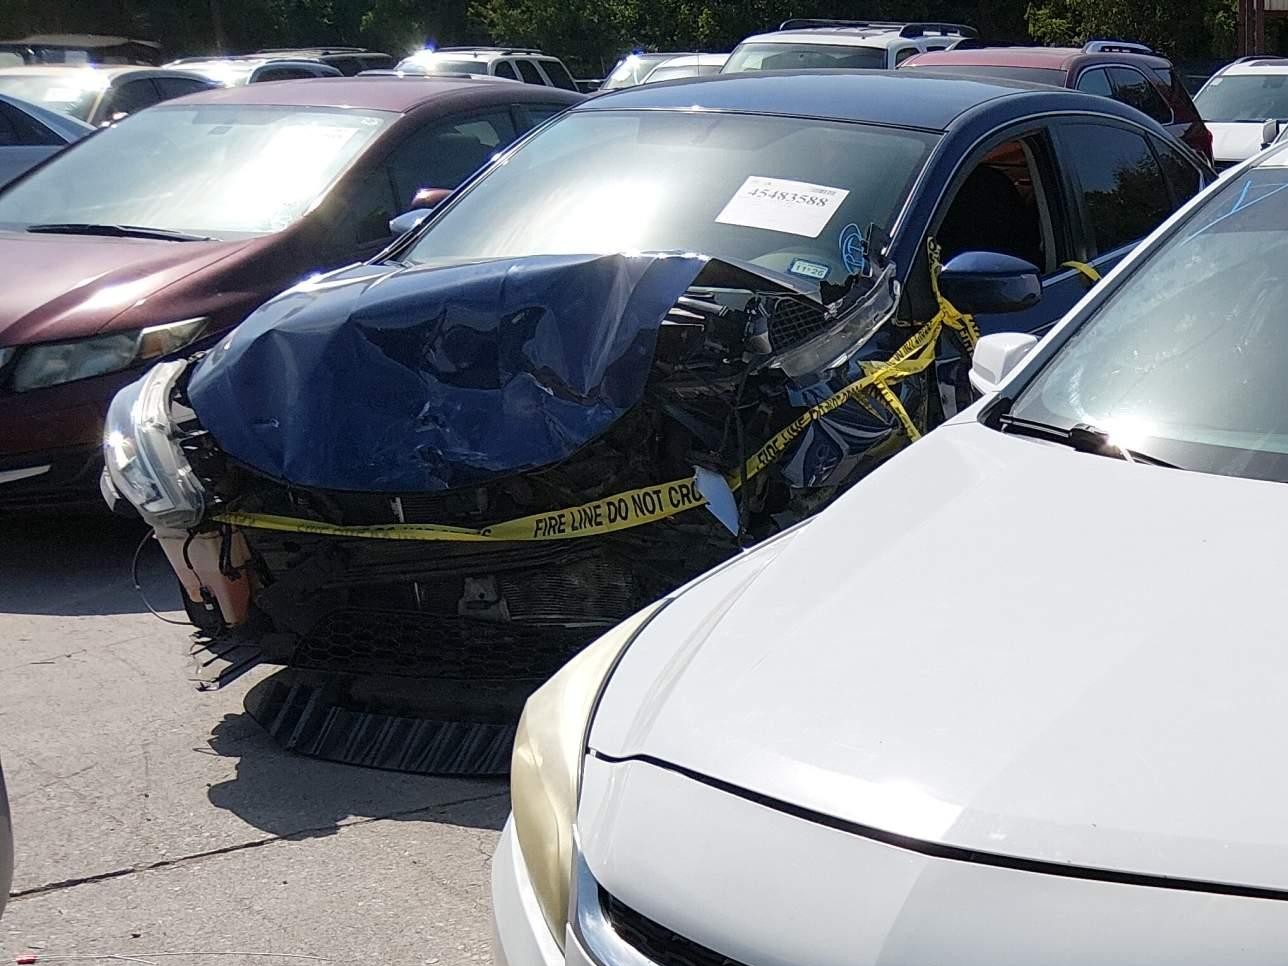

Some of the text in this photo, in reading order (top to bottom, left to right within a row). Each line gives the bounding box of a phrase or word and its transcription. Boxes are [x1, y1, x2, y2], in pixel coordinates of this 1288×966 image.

[747, 187, 829, 208] 45483588
[534, 480, 702, 538] FIRE LINE DO NOT CRO
